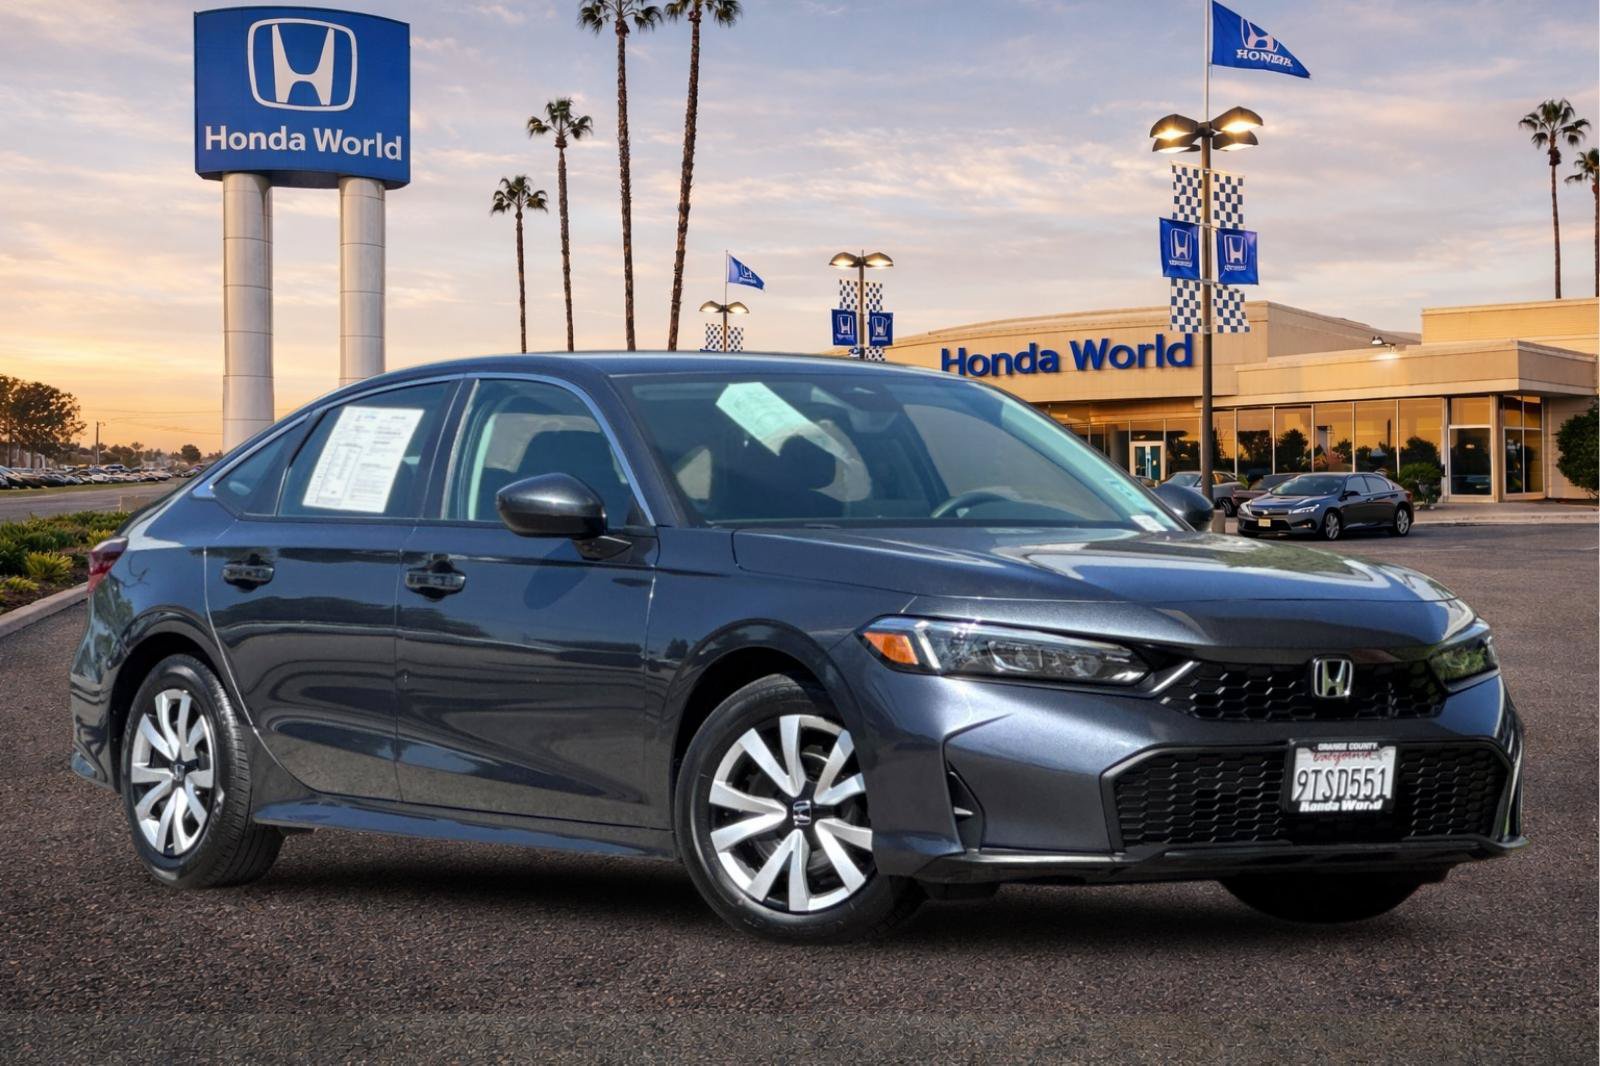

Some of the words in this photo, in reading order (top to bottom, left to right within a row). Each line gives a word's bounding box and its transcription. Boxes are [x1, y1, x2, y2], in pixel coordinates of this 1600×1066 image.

[205, 125, 306, 151] Honda
[312, 127, 402, 160] World
[941, 342, 1061, 377] Honda
[1069, 333, 1195, 371] World
[1348, 742, 1378, 750] COUNTY
[1295, 767, 1386, 801] 9TSD551
[1299, 800, 1340, 812] Honda
